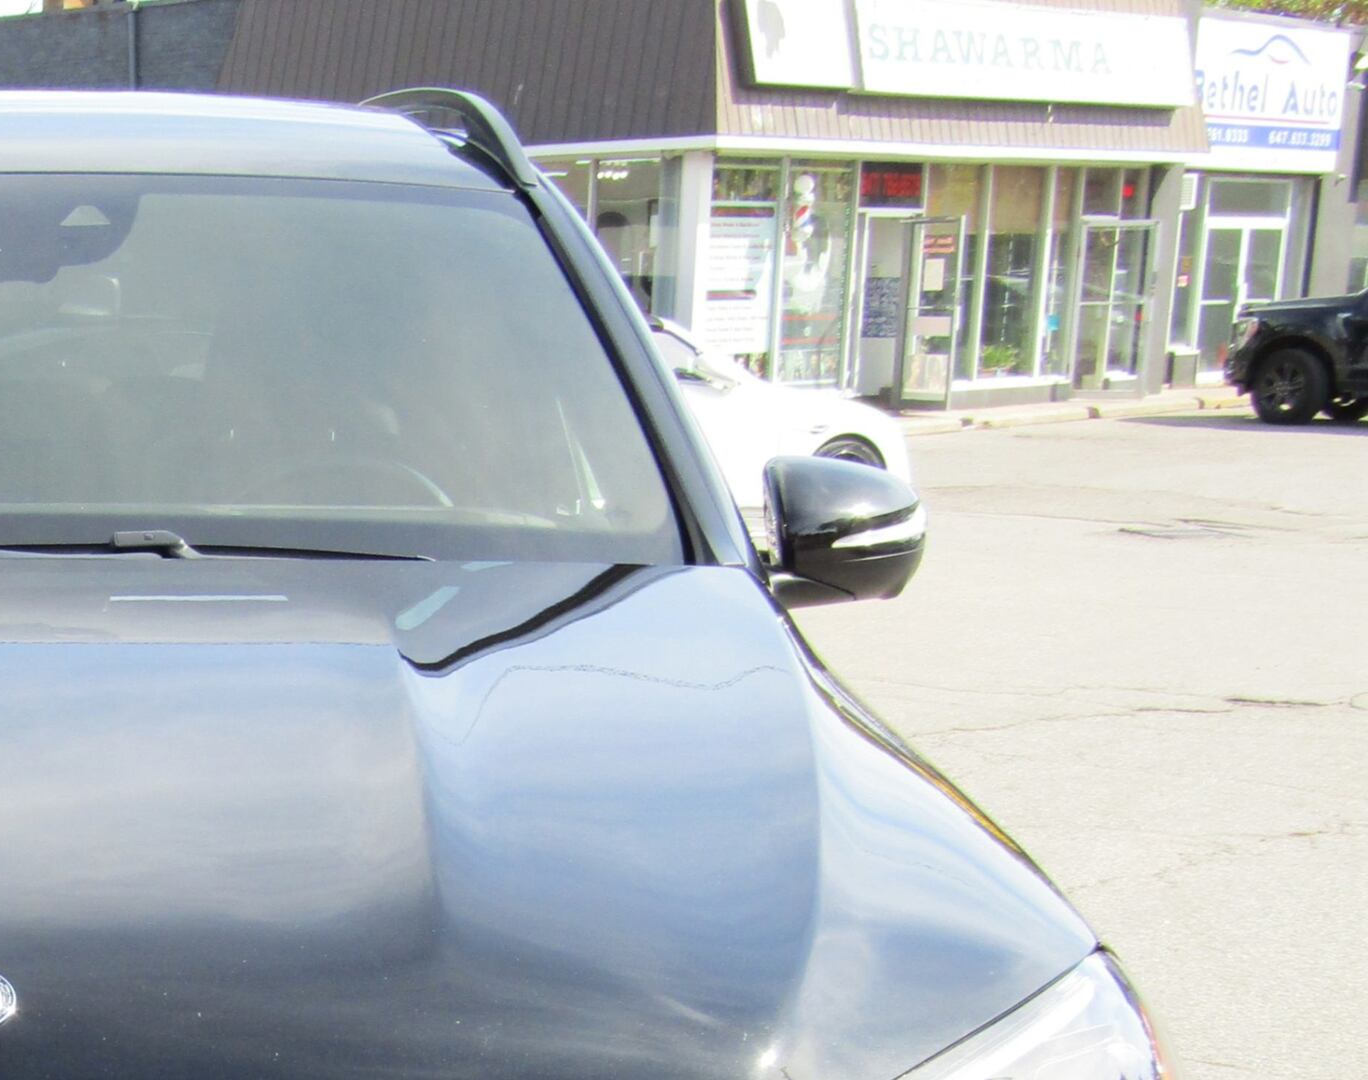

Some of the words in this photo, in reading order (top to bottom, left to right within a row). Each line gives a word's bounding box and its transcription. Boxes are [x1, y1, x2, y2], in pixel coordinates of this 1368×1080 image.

[868, 23, 1113, 74] SHAWARMA
[1195, 70, 1269, 112] Bethel
[1282, 80, 1338, 117] Auto
